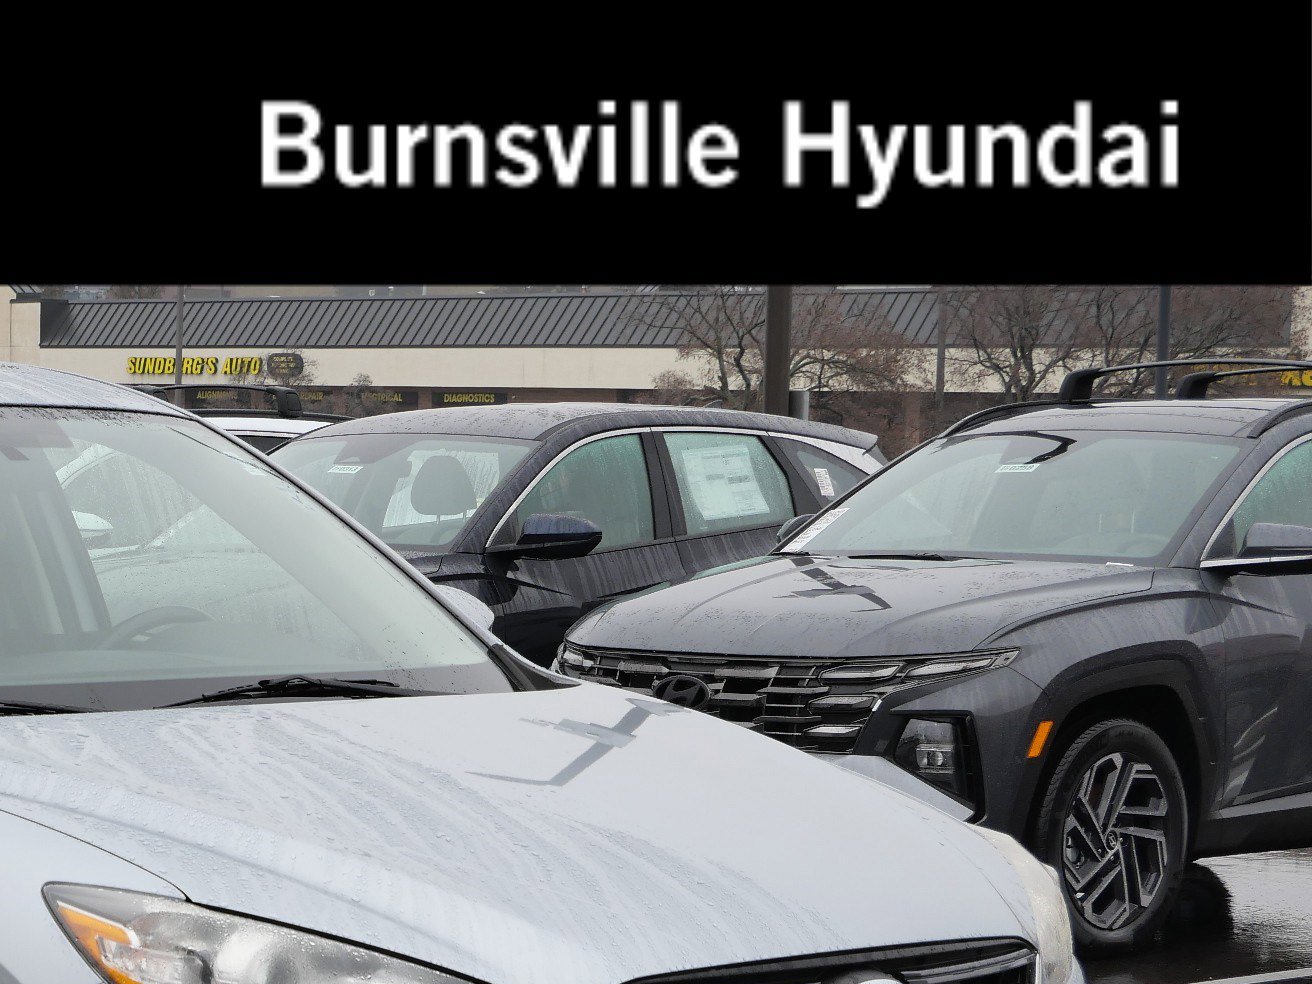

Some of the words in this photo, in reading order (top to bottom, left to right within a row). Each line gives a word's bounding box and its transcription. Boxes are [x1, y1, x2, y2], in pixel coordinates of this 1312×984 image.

[126, 356, 218, 375] SUNDBRG'S
[222, 356, 262, 375] AUTO
[443, 393, 495, 403] DIAGNOSTICS
